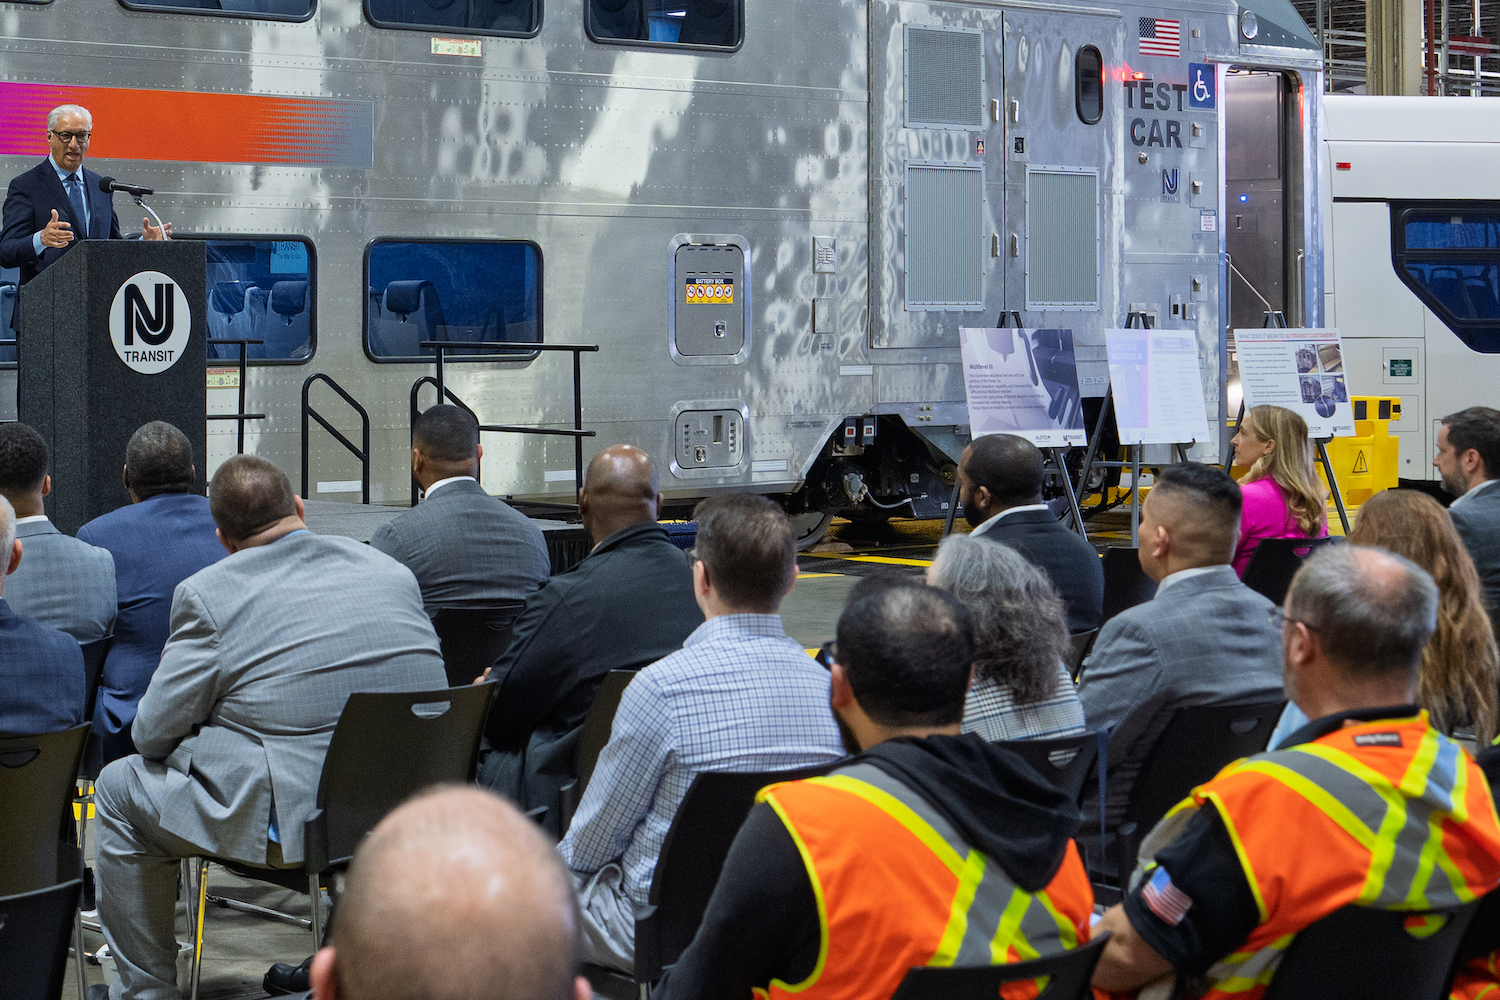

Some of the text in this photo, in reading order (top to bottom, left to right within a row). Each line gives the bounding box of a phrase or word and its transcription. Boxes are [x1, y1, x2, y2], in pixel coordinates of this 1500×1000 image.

[1124, 80, 1187, 112] TEST
[1130, 118, 1183, 148] CAR
[124, 283, 174, 346] NJ
[124, 350, 175, 363] TRANSIT
